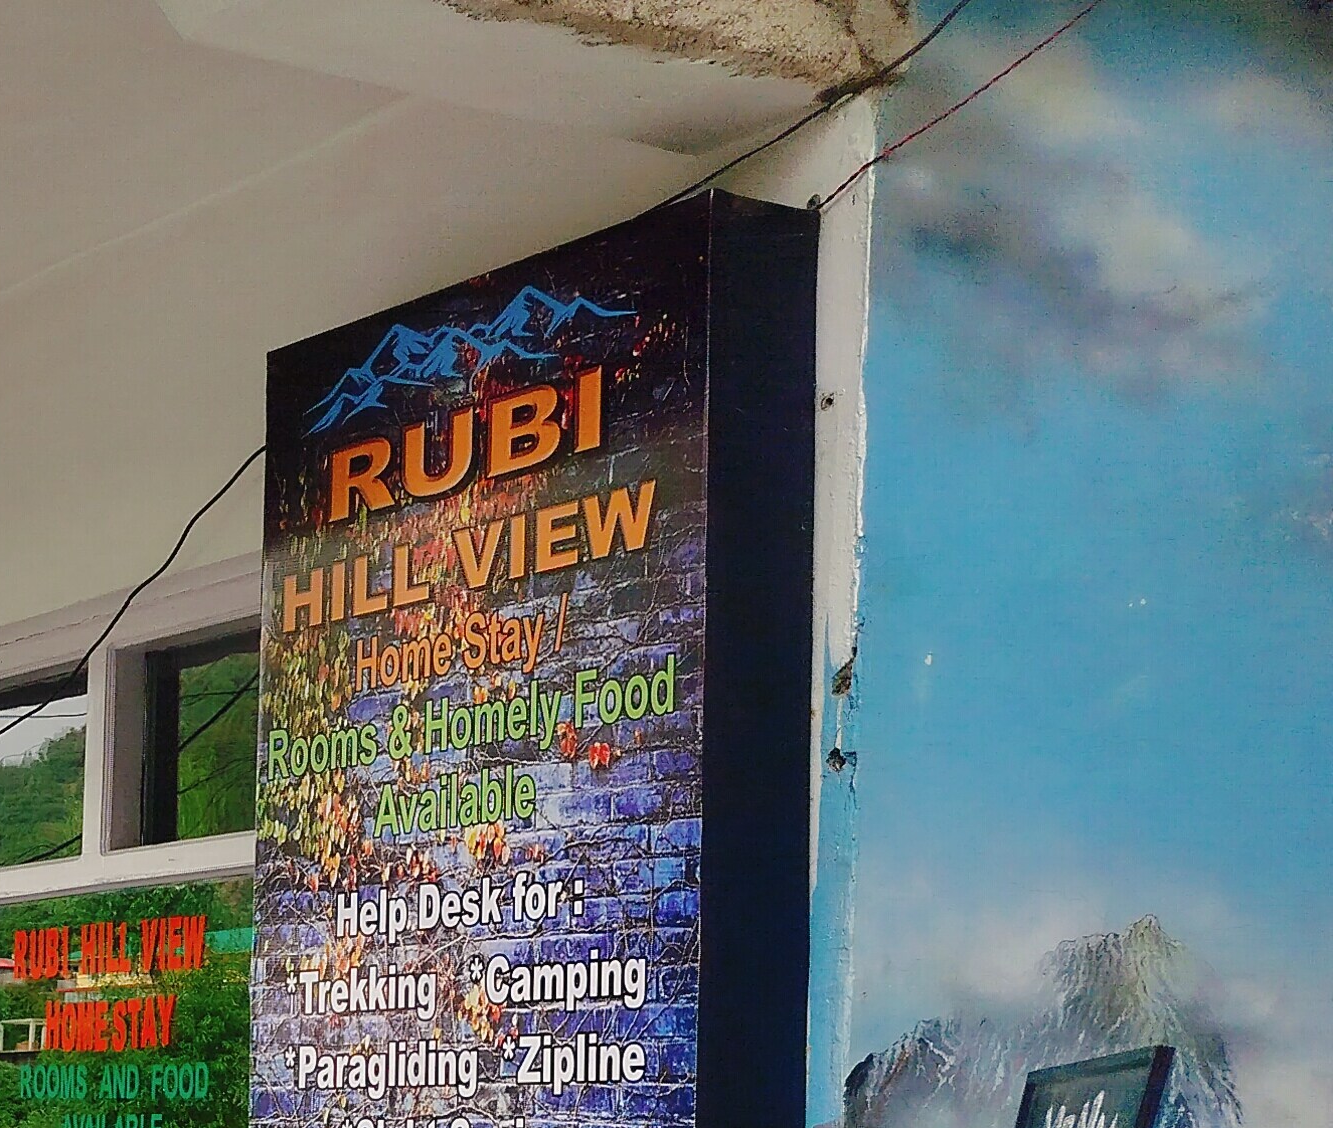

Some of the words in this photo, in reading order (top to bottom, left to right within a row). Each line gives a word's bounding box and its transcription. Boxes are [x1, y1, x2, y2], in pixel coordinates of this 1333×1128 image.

[328, 364, 602, 523] RUBI
[282, 541, 430, 632] HILL
[455, 480, 656, 591] VIEW
[355, 632, 450, 691] Home
[463, 606, 541, 673] Stay
[267, 726, 377, 781] Rooms
[388, 705, 412, 759] &
[424, 682, 561, 750] Homely
[574, 655, 676, 727] Food
[374, 766, 536, 838] Available
[336, 893, 408, 943] Help
[419, 877, 502, 930] Desk
[513, 871, 563, 920] for
[13, 926, 69, 980] RUBI
[80, 921, 132, 975] HILL
[141, 914, 207, 972] VIEW
[44, 994, 177, 1053] HOMESTAY
[20, 1063, 87, 1099] ROOMS
[99, 1064, 140, 1099] AND
[152, 1062, 209, 1100] FOOD
